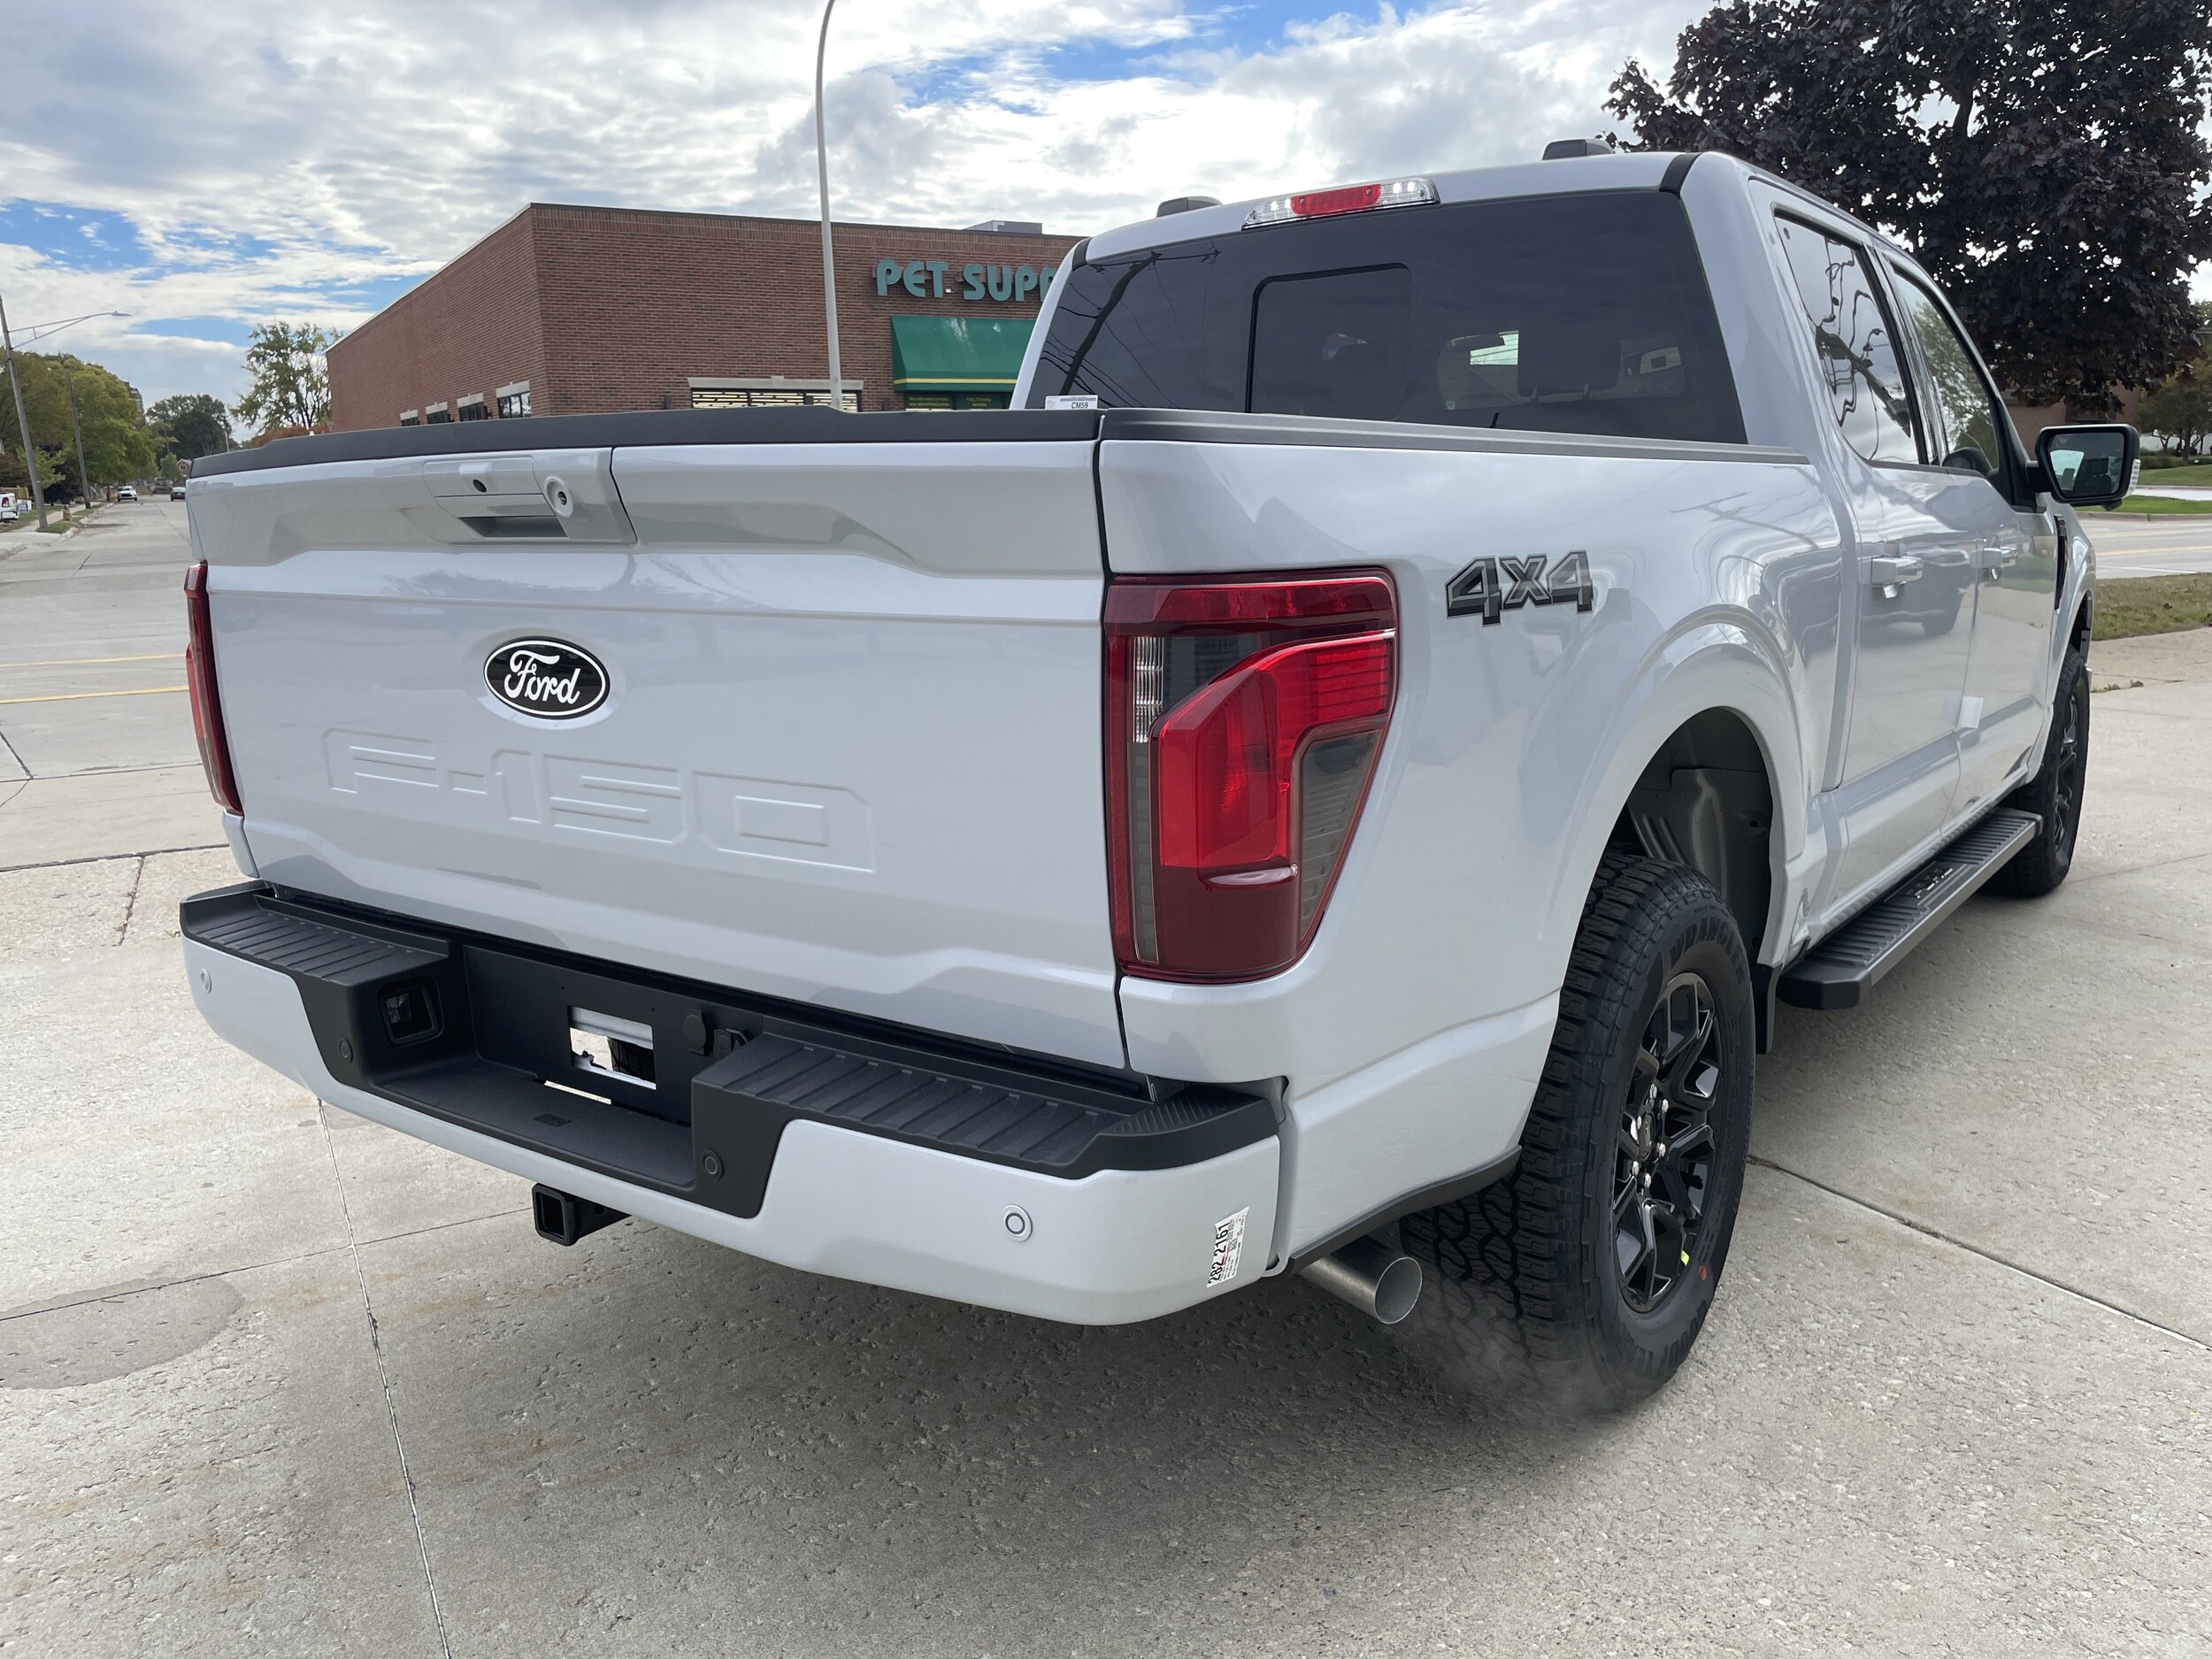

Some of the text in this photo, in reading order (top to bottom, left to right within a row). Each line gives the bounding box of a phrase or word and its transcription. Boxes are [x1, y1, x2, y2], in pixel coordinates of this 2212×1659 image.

[875, 258, 949, 297] PET
[503, 649, 581, 704] Ford
[322, 727, 876, 873] F-150
[1208, 1222, 1231, 1284] 282 2161
